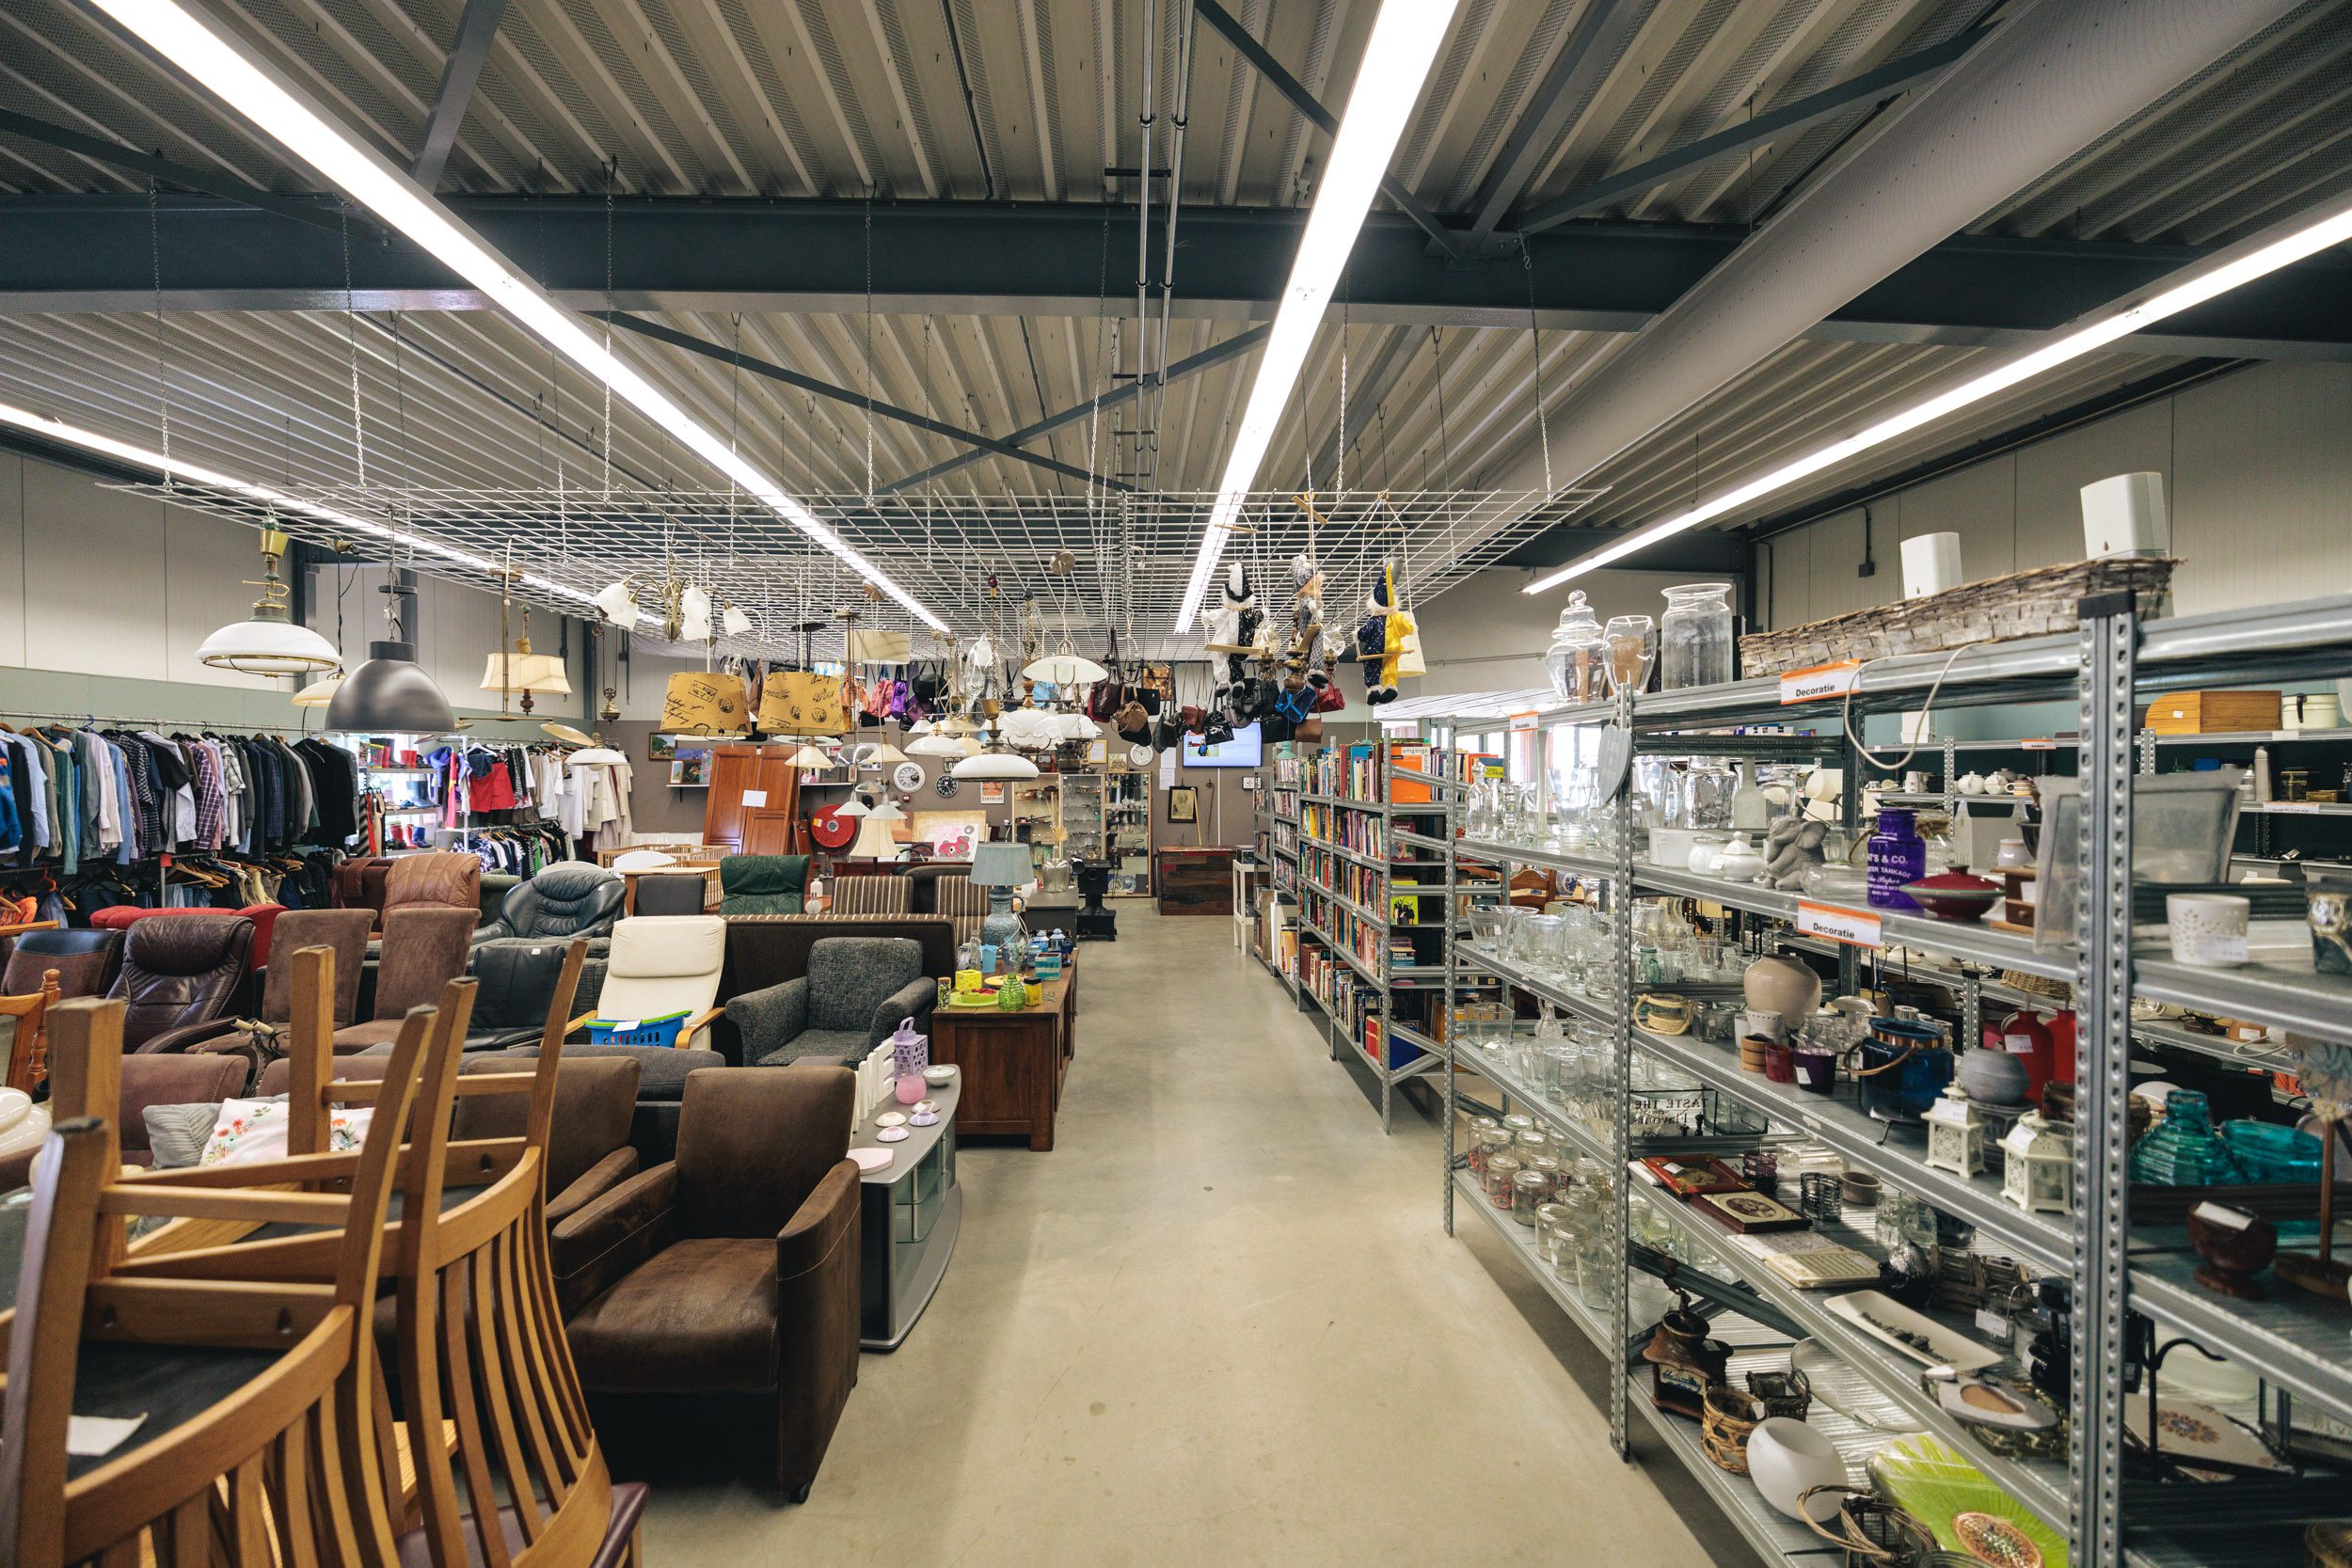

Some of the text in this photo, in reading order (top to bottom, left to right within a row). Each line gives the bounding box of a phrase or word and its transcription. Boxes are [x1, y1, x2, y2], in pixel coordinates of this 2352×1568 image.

[1796, 684, 1836, 697] Decoratie
[1882, 855, 1889, 864] &
[1891, 855, 1909, 864] CO.
[1881, 866, 1912, 879] TANKAGE
[1813, 922, 1855, 940] Decoratie
